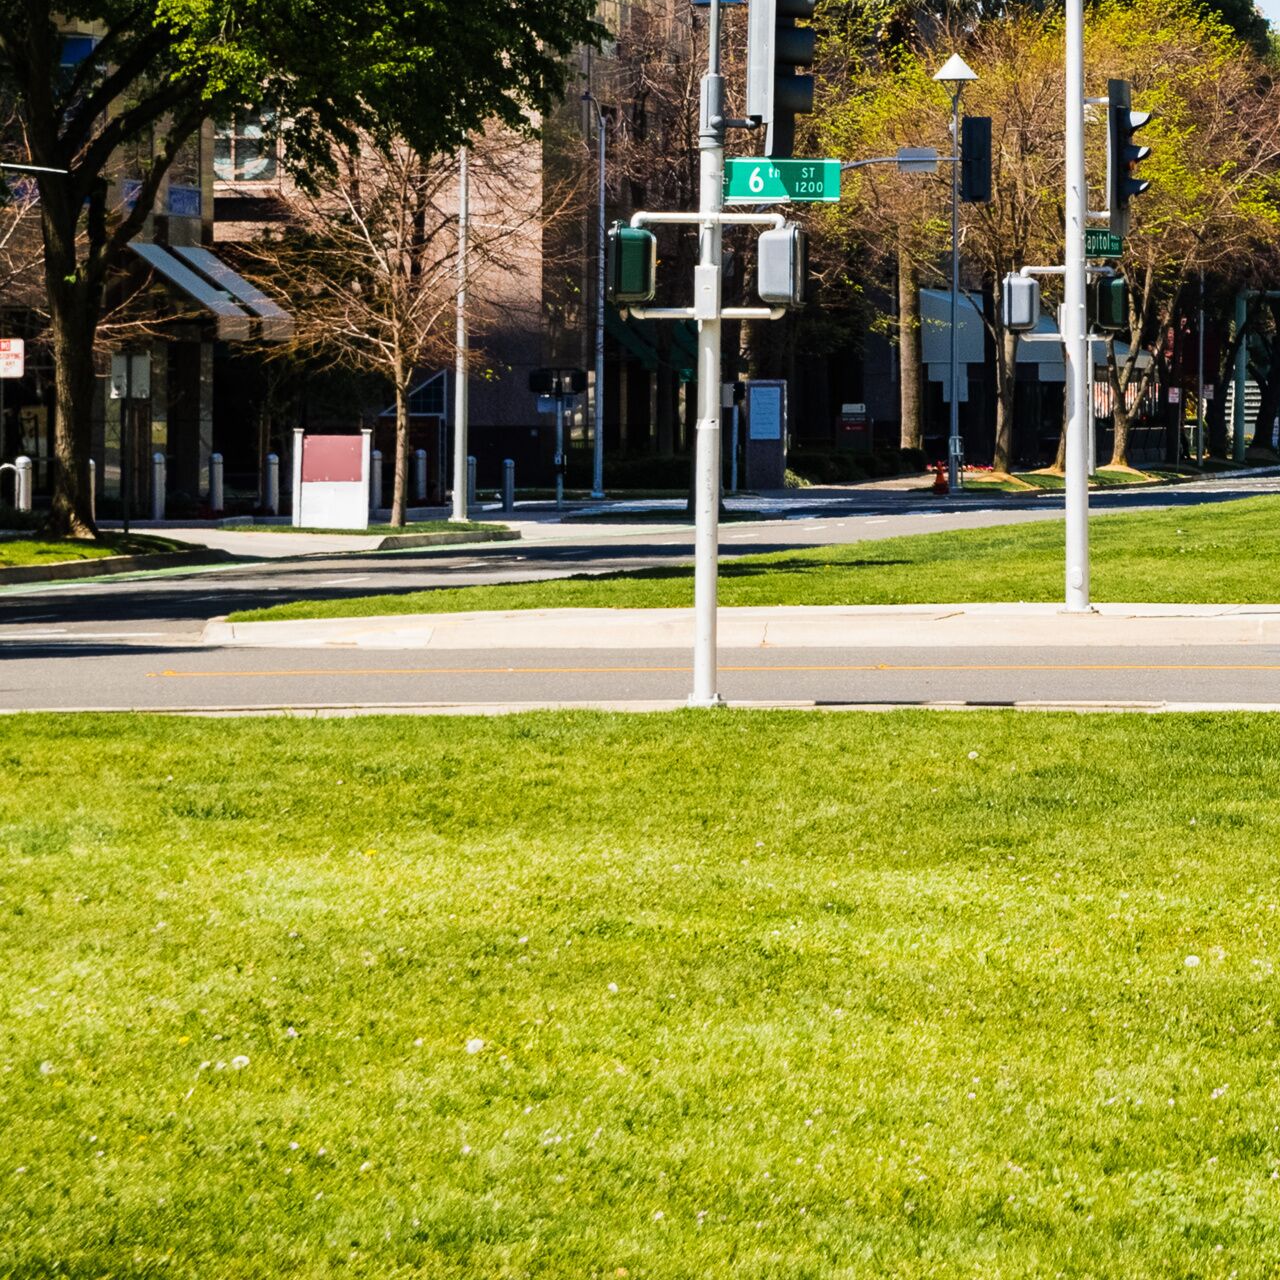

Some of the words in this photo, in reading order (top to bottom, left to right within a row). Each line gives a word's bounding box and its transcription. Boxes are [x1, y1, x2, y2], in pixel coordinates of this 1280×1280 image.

[802, 167, 815, 178] ST
[795, 182, 823, 193] 1200
[1085, 232, 1110, 254] apitol
